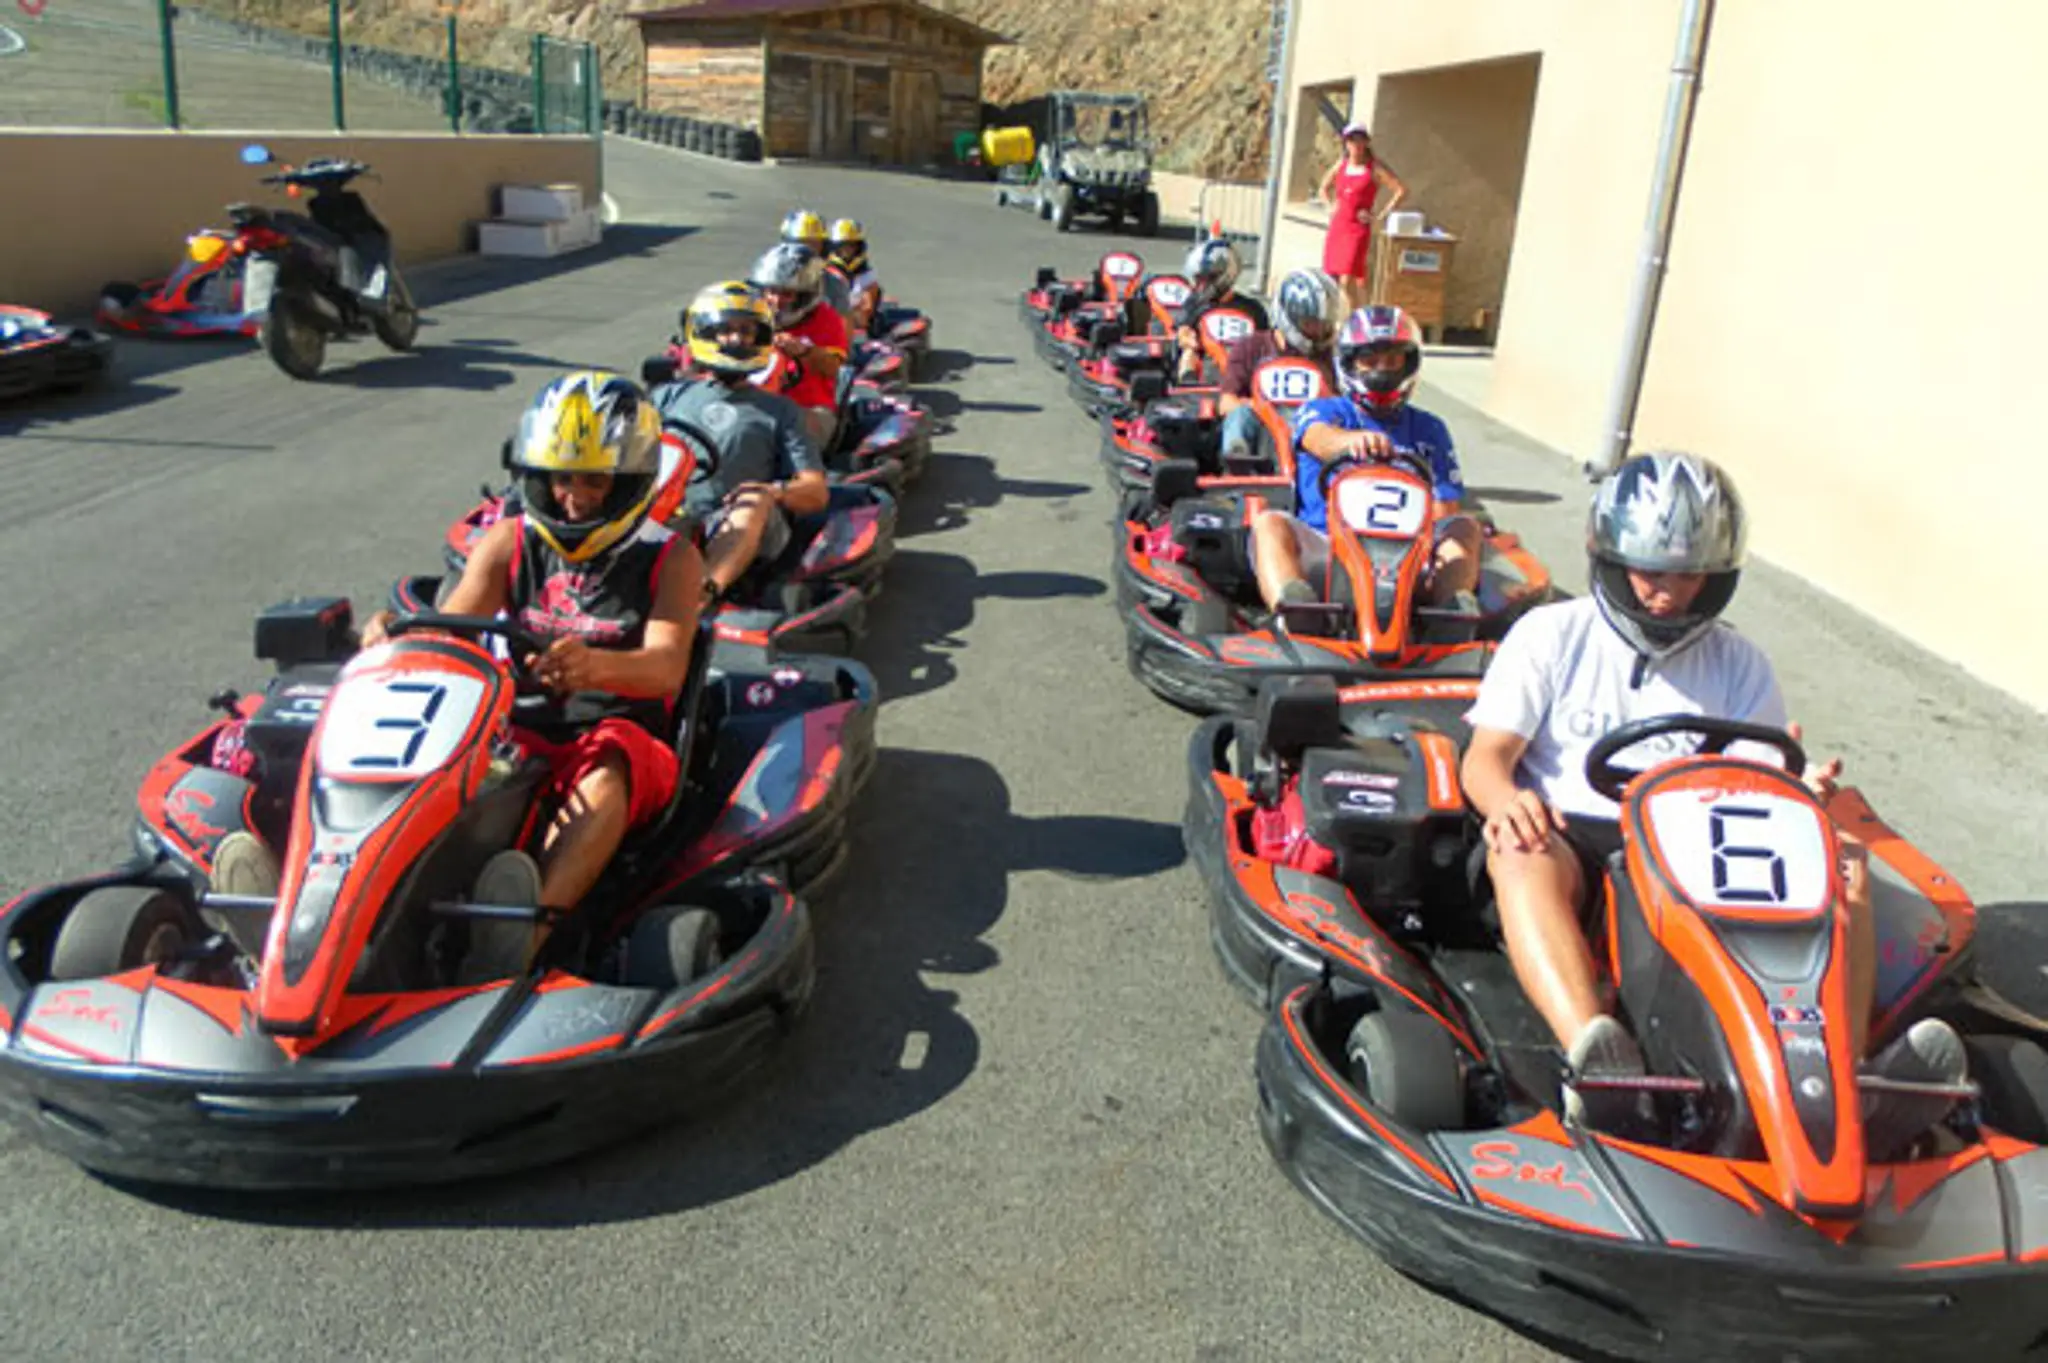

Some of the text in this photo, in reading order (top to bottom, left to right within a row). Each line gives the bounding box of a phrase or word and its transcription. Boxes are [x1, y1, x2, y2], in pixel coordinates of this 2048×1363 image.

[1270, 370, 1310, 399] 10
[1367, 486, 1408, 529] 2
[349, 682, 446, 767] 3
[1709, 805, 1787, 902] 6
[1470, 1141, 1598, 1205] Sodi
